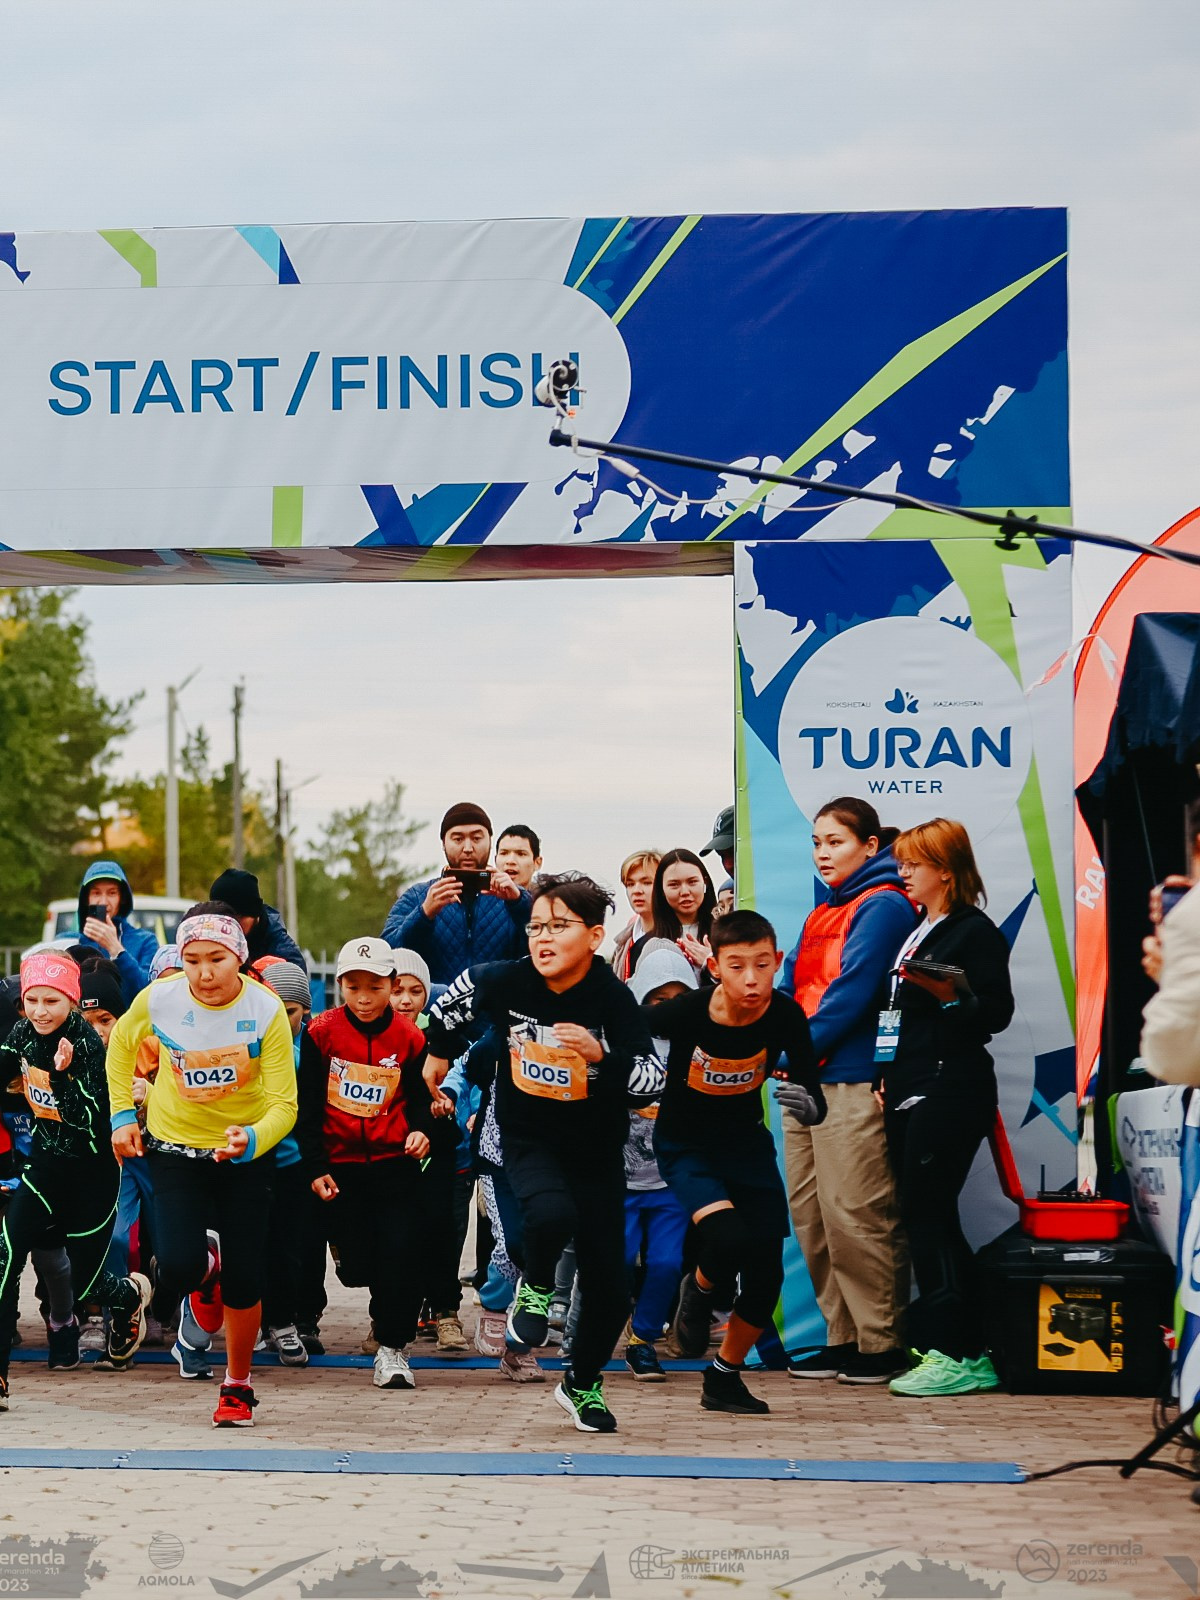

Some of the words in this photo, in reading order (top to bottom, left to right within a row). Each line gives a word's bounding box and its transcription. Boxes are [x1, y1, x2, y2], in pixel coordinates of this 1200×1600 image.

[798, 726, 1012, 769] TURAN
[868, 780, 943, 794] WATER
[357, 944, 371, 958] R
[184, 1068, 236, 1086] 1042
[522, 1060, 569, 1085] 1005
[704, 1071, 754, 1085] 1040
[343, 1082, 382, 1103] 1041
